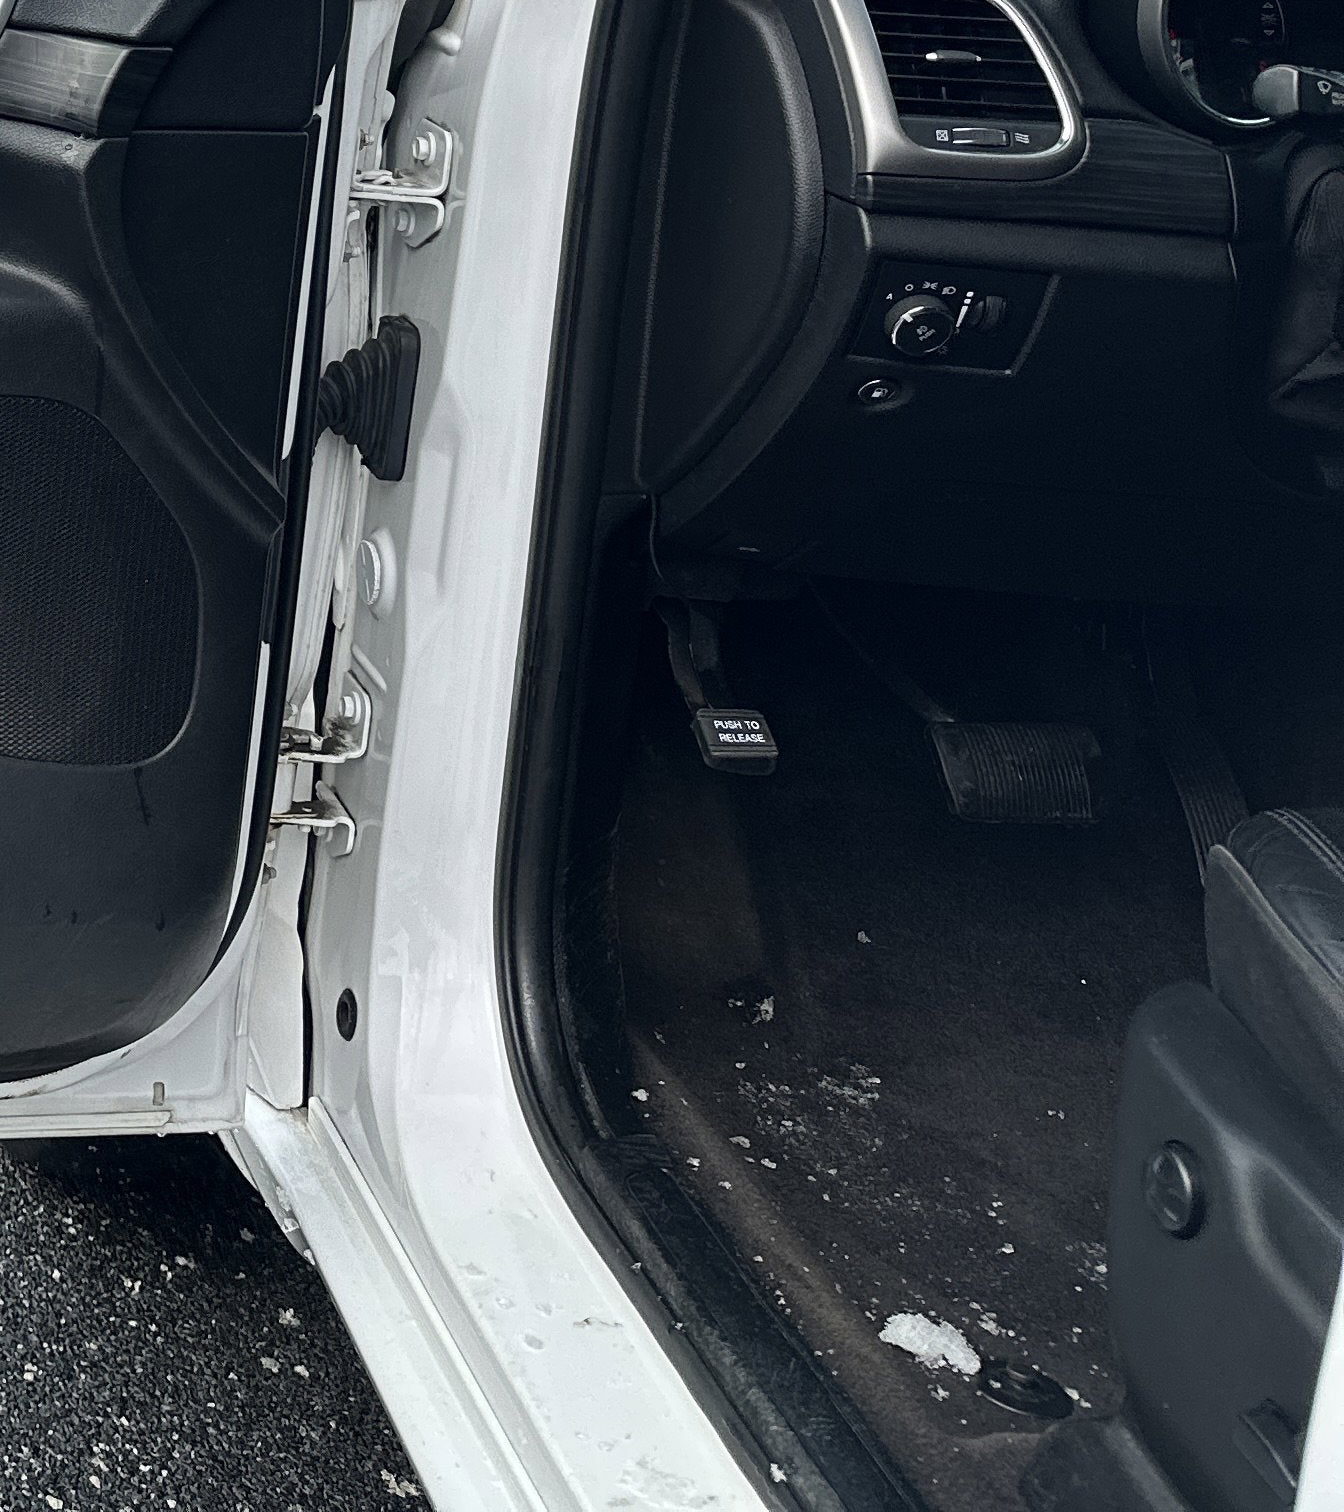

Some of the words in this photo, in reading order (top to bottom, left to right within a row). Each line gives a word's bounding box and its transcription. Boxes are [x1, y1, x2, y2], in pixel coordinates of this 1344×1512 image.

[713, 719, 743, 730] PUSH
[743, 720, 760, 730] TO
[718, 732, 766, 743] RELEASE
